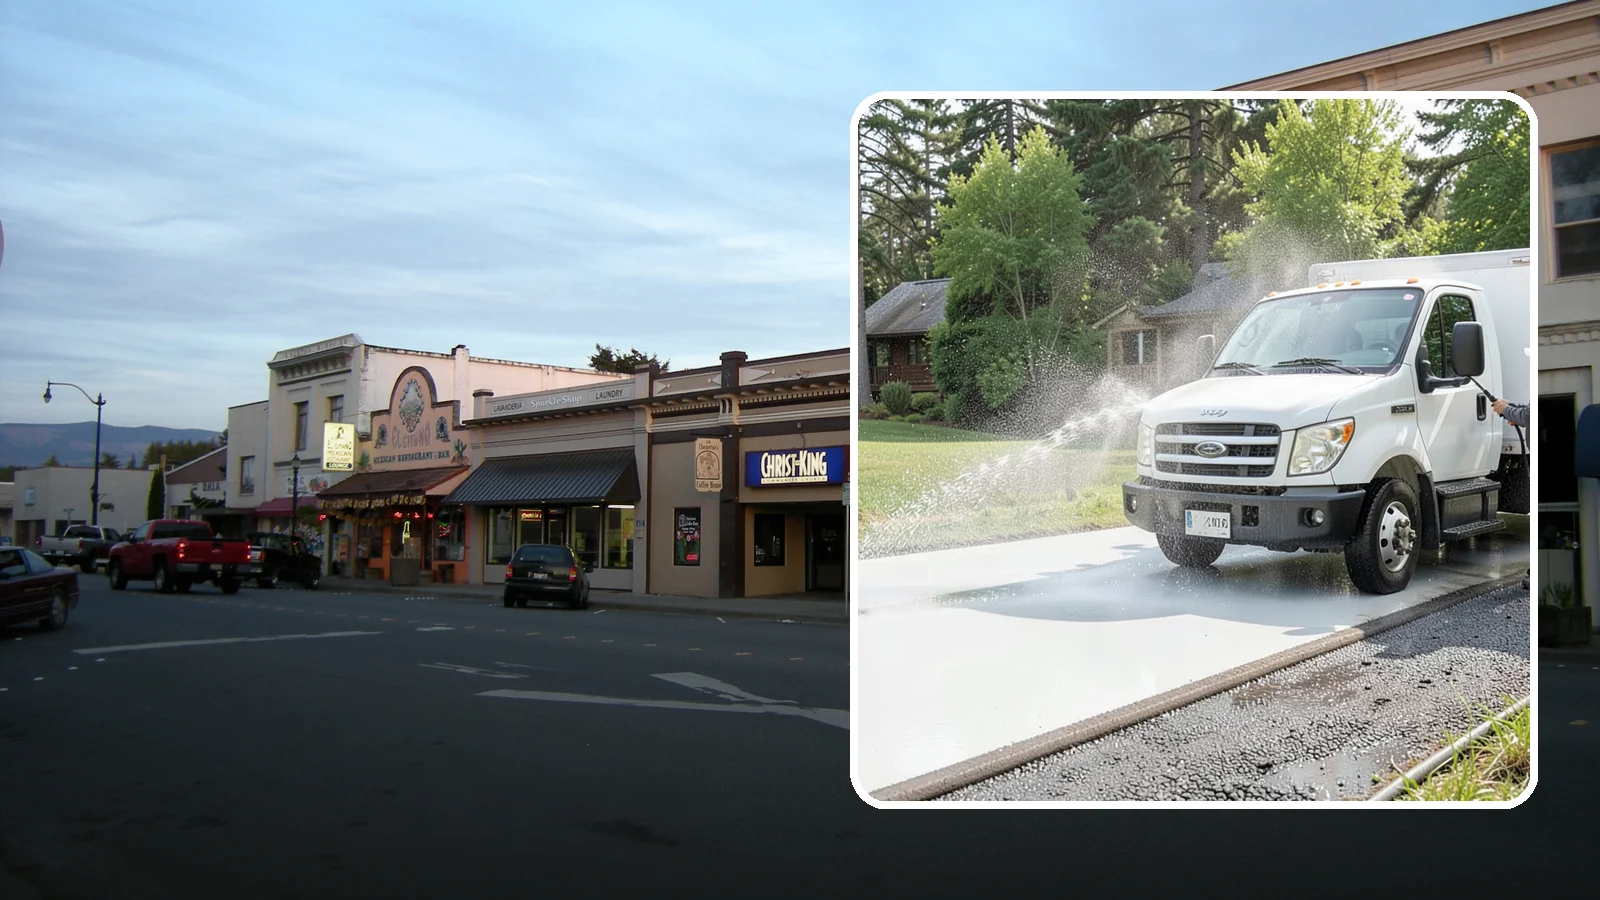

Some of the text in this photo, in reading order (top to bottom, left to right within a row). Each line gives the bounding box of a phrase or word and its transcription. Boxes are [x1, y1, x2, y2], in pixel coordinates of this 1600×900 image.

[596, 389, 624, 400] LAUNDRY
[493, 402, 522, 412] LAVANDERIA
[531, 394, 583, 409] Sparkle Shop
[373, 455, 397, 464] MEXICAN
[398, 452, 433, 462] RESTAURANT
[438, 450, 450, 459] BAR
[760, 450, 828, 478] CHRIST KING
[696, 480, 722, 489] Coffee House
